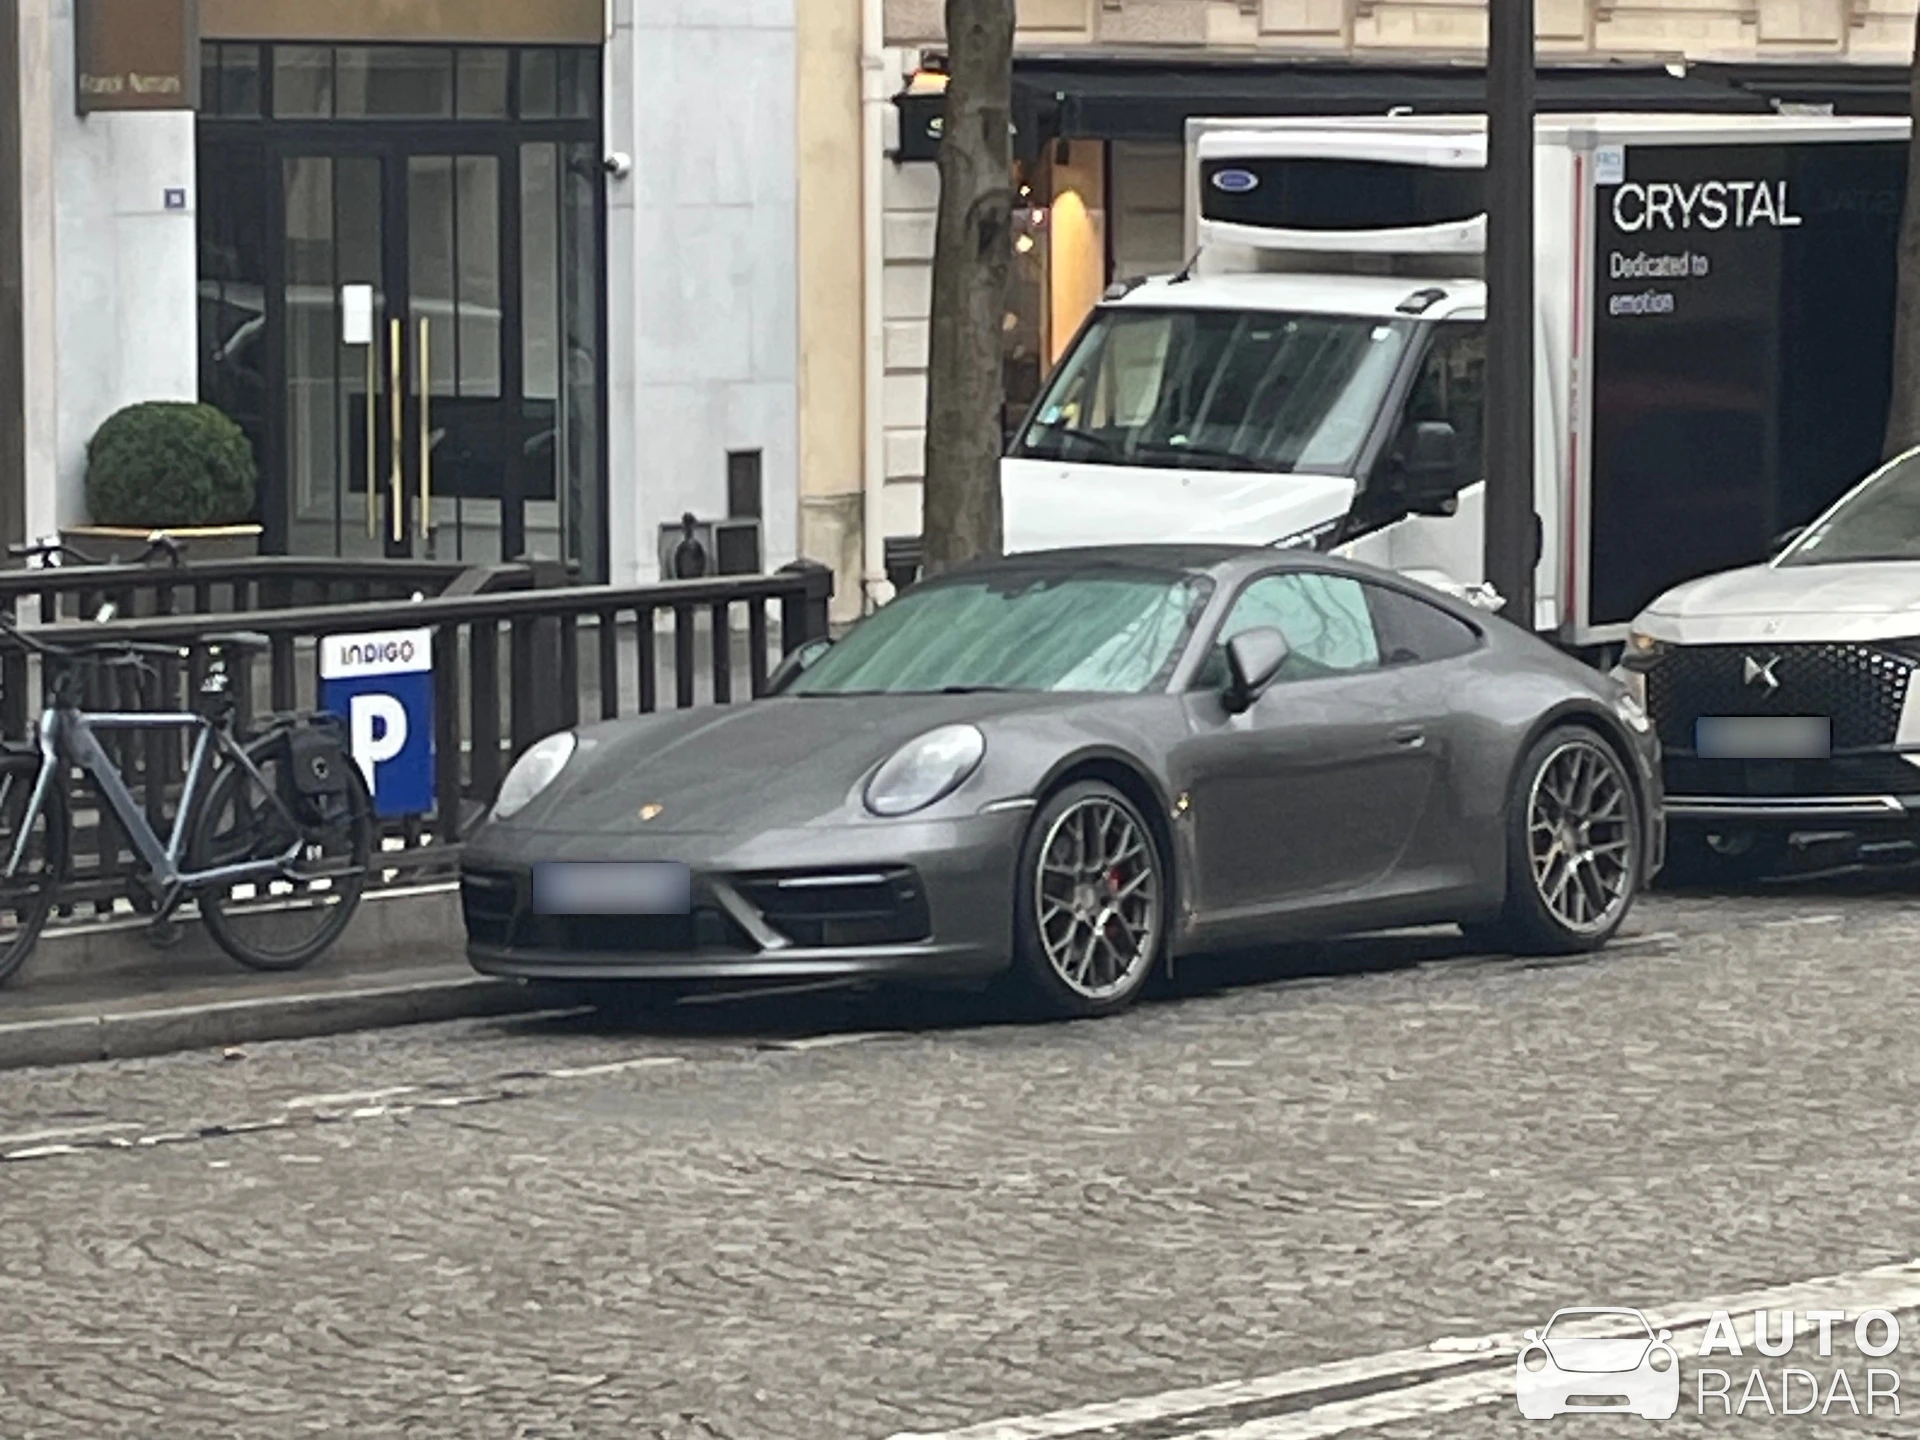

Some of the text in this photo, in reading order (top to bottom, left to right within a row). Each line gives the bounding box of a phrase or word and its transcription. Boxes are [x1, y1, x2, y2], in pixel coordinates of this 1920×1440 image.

[1612, 180, 1802, 231] CRYSTAL
[1609, 250, 1709, 279] Dedicated to
[1609, 288, 1675, 316] emotion
[350, 693, 409, 797] P
